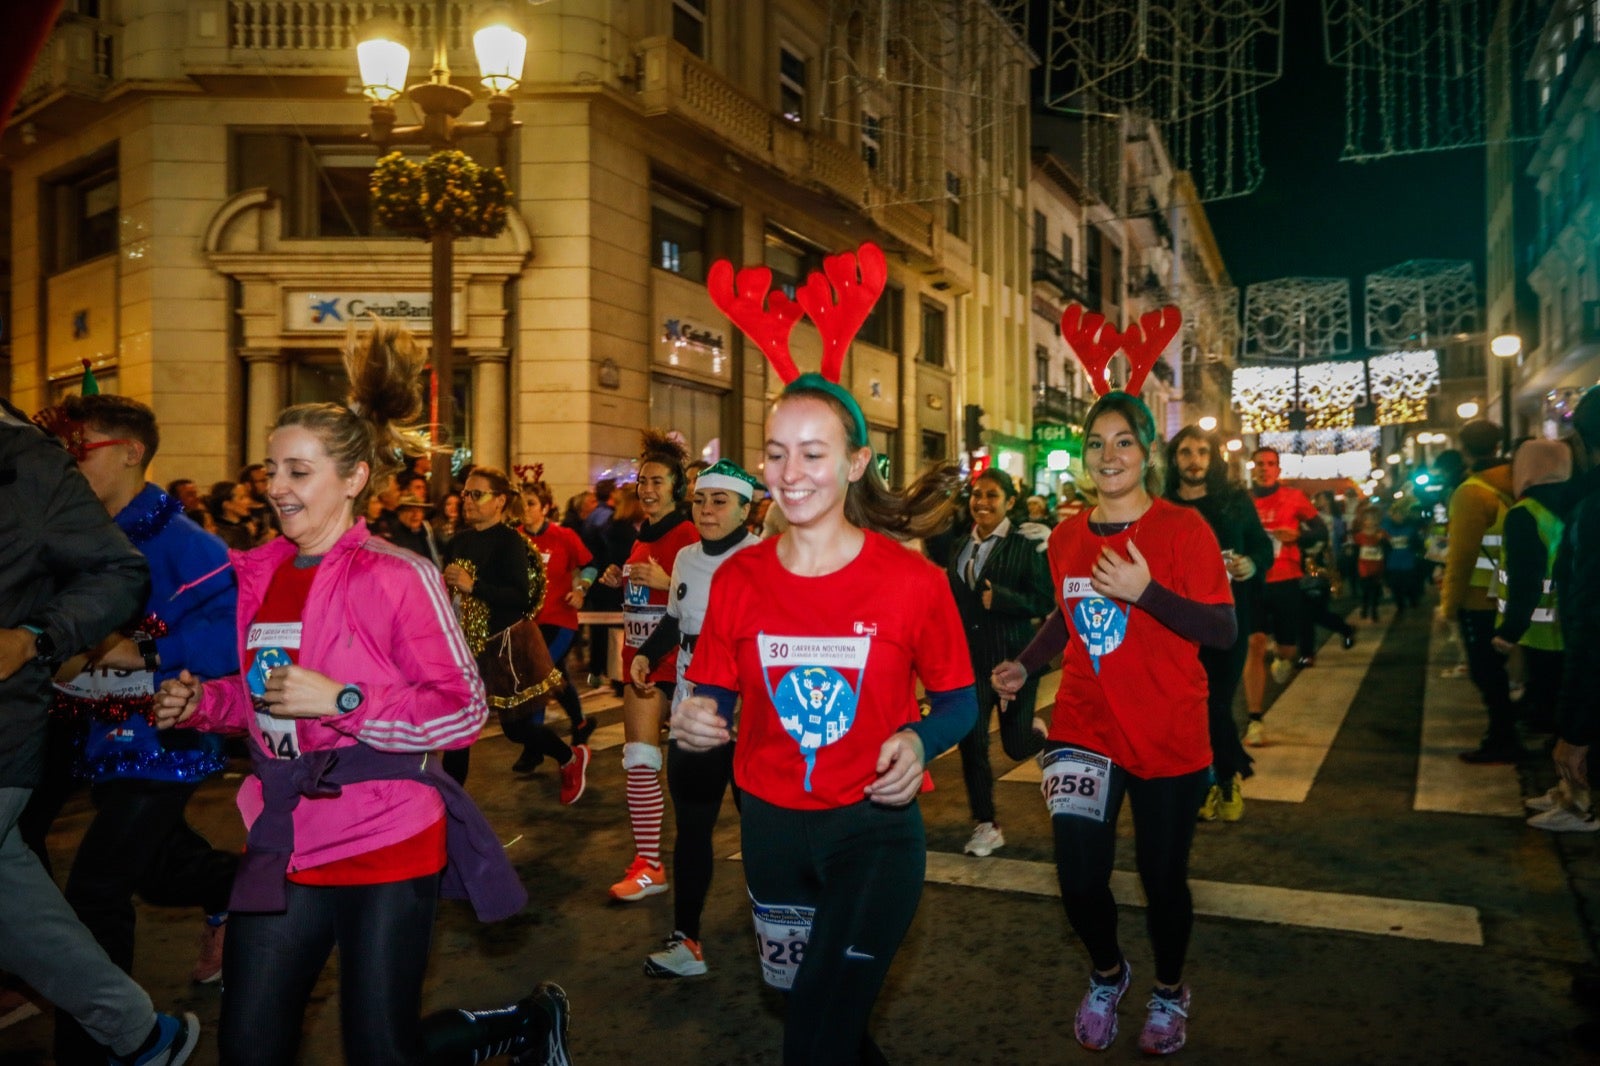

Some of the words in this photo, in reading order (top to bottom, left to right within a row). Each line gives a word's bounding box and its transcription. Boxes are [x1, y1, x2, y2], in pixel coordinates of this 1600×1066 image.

[347, 300, 433, 317] CaixaBan
[1068, 582, 1081, 593] 30
[249, 628, 262, 643] 30
[627, 621, 658, 636] 101
[769, 643, 789, 658] 30
[1043, 774, 1095, 801] 1258
